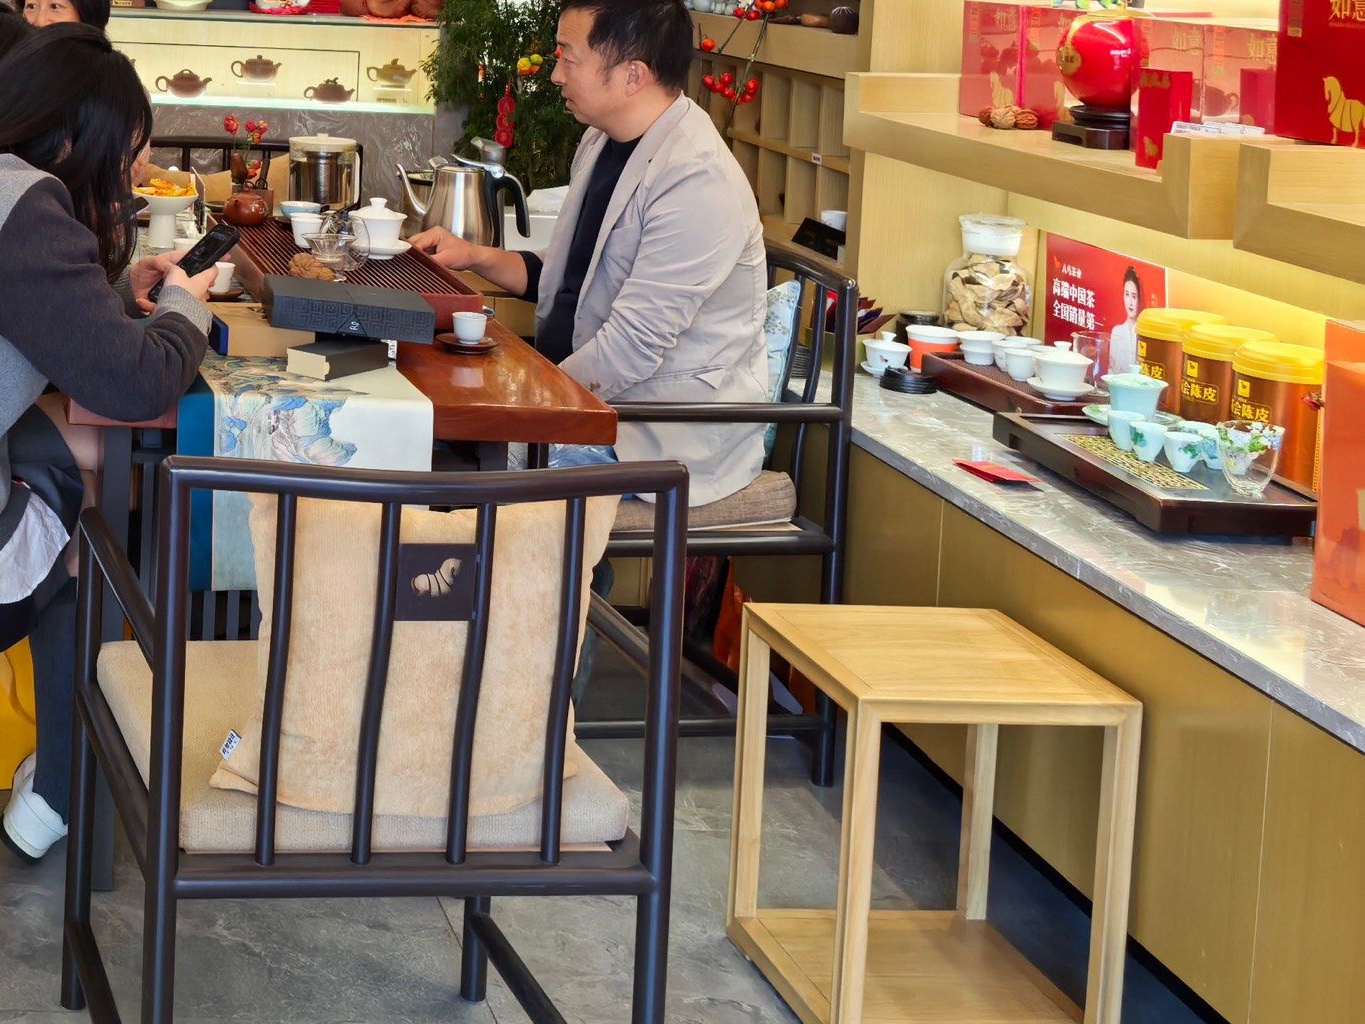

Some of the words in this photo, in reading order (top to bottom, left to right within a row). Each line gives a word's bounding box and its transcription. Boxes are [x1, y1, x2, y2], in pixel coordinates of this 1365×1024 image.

[1052, 277, 1095, 308] 高端中国茶
[1052, 299, 1104, 330] 全国销量第一
